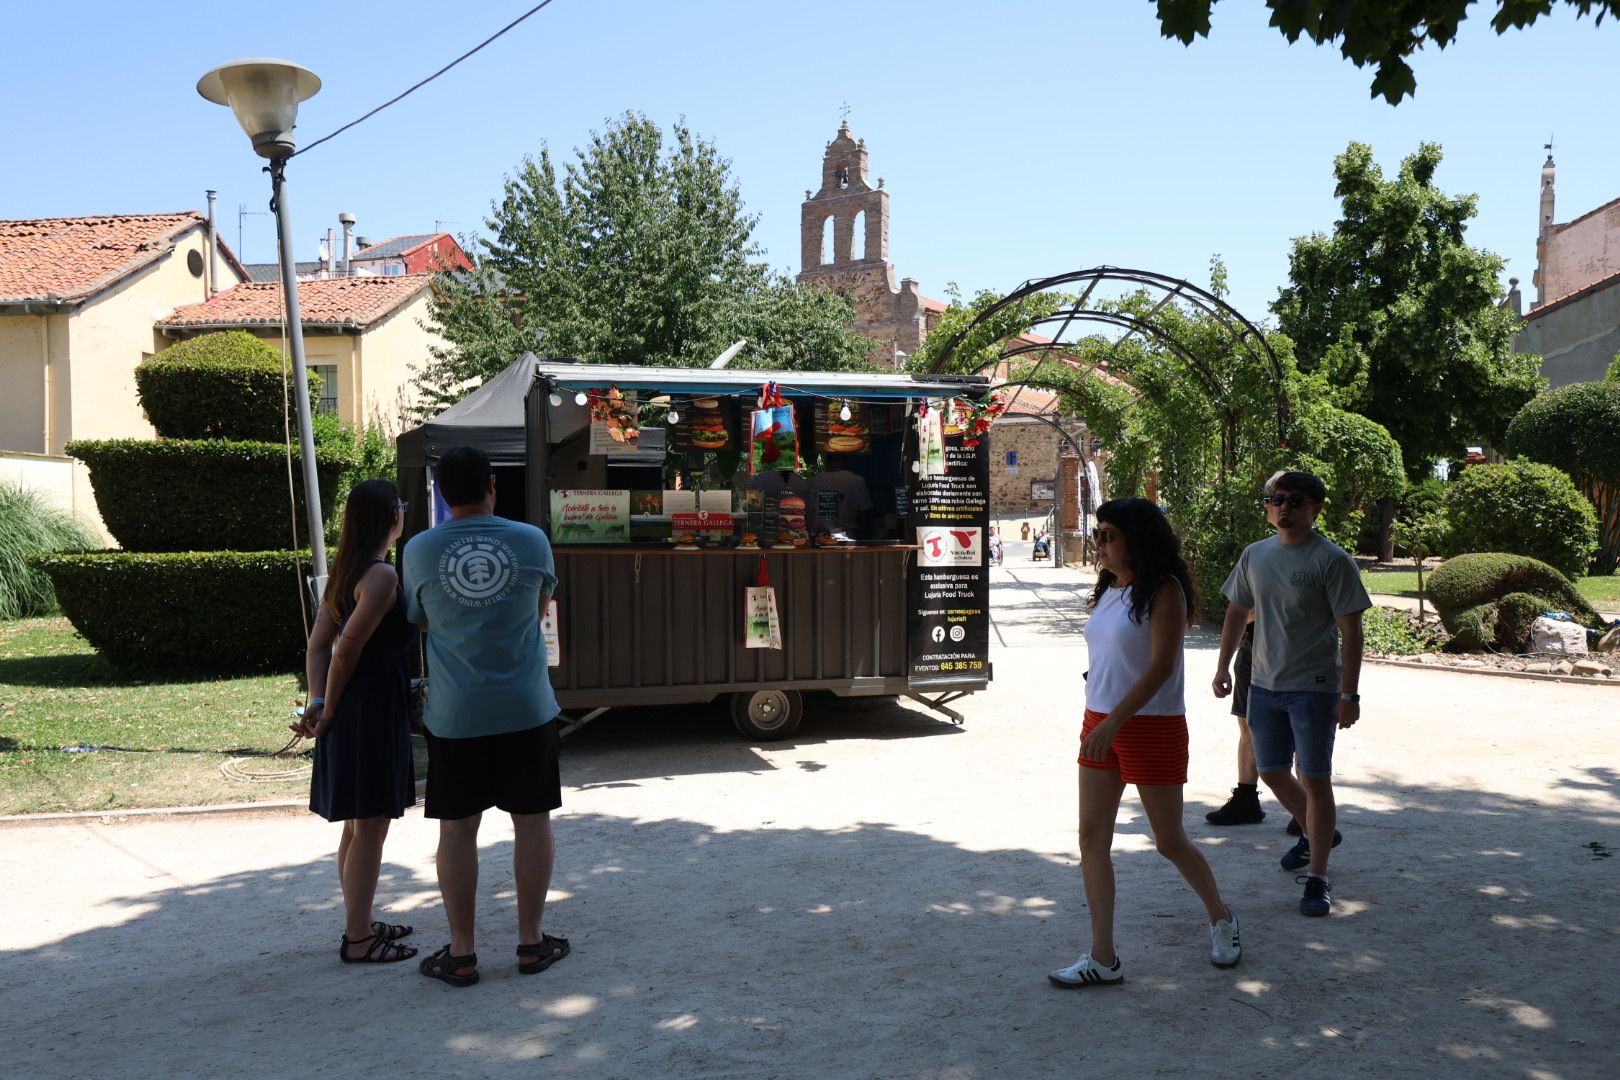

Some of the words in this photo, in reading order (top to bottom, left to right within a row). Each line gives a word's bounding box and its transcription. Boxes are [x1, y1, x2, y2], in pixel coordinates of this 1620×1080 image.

[934, 573, 970, 581] hamburguesa
[922, 652, 960, 661] CONTRATACIÓN
[941, 662, 953, 670] 645
